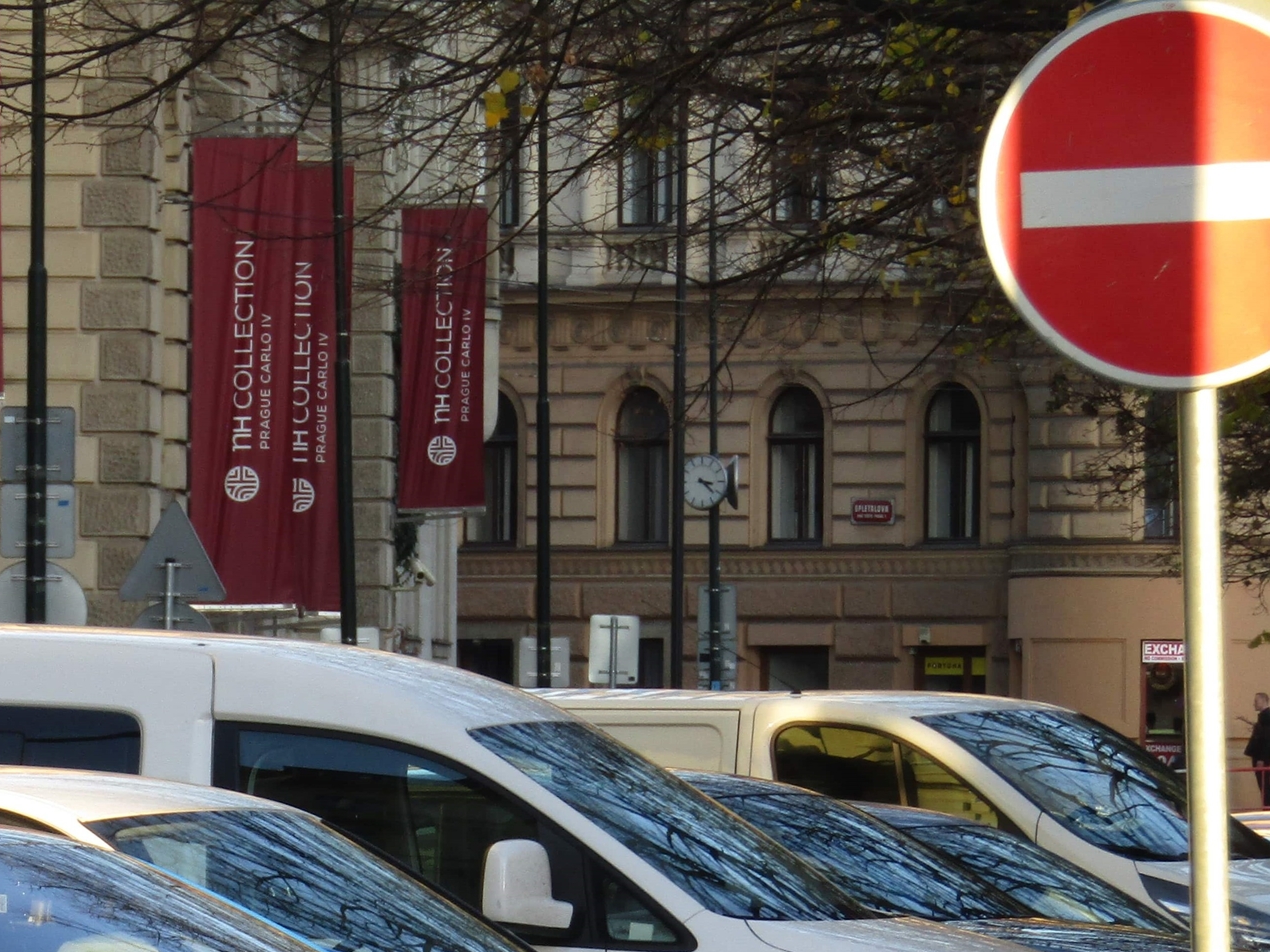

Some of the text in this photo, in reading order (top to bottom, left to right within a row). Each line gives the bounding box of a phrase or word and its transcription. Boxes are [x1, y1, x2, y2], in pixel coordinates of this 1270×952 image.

[233, 240, 255, 410] COLLECTION
[259, 313, 272, 450] PRAGUE CARLO IV
[435, 247, 453, 389] COLLECTION
[460, 308, 472, 422] PRAGUE CARLO IV
[315, 332, 329, 463] PRAGUE CARLO IV
